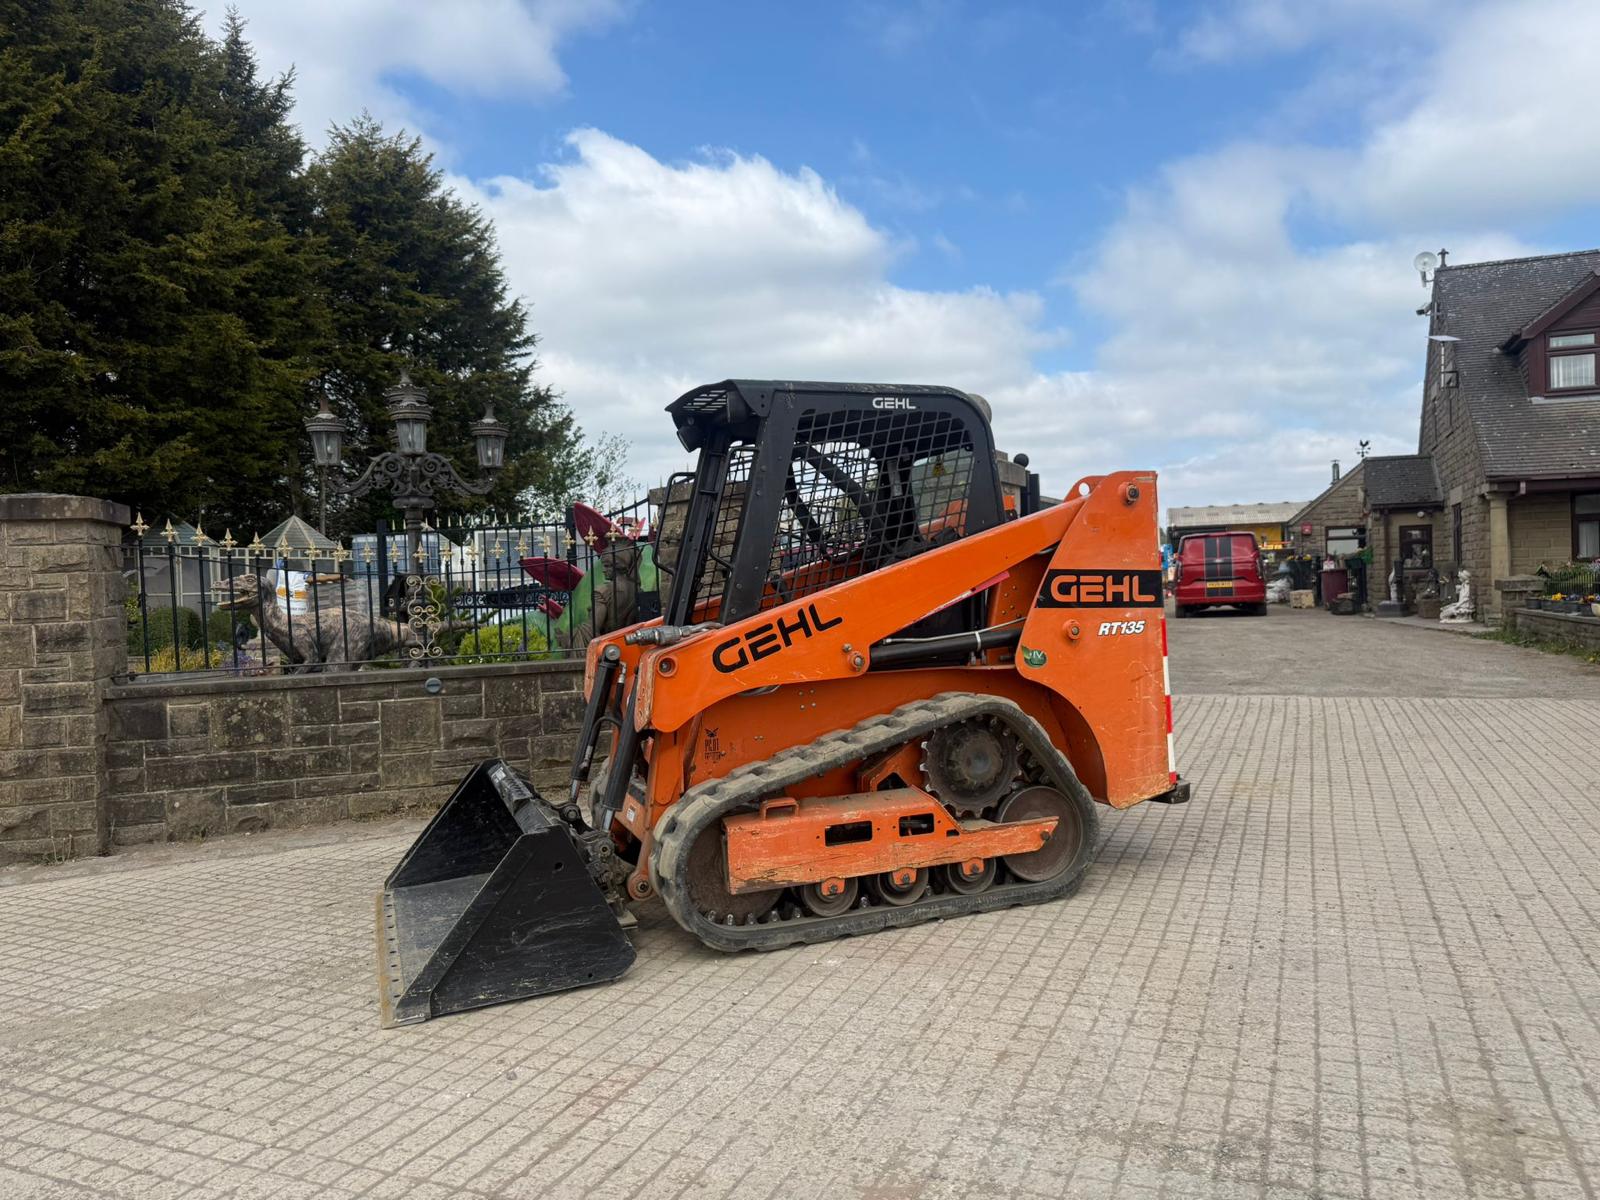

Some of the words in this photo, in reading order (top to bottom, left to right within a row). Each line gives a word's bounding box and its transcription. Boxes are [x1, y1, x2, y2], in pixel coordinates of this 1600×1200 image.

[873, 397, 916, 409] GEHL
[1051, 575, 1155, 602] GEHL
[712, 603, 843, 673] GEHL
[1098, 620, 1146, 636] RT135
